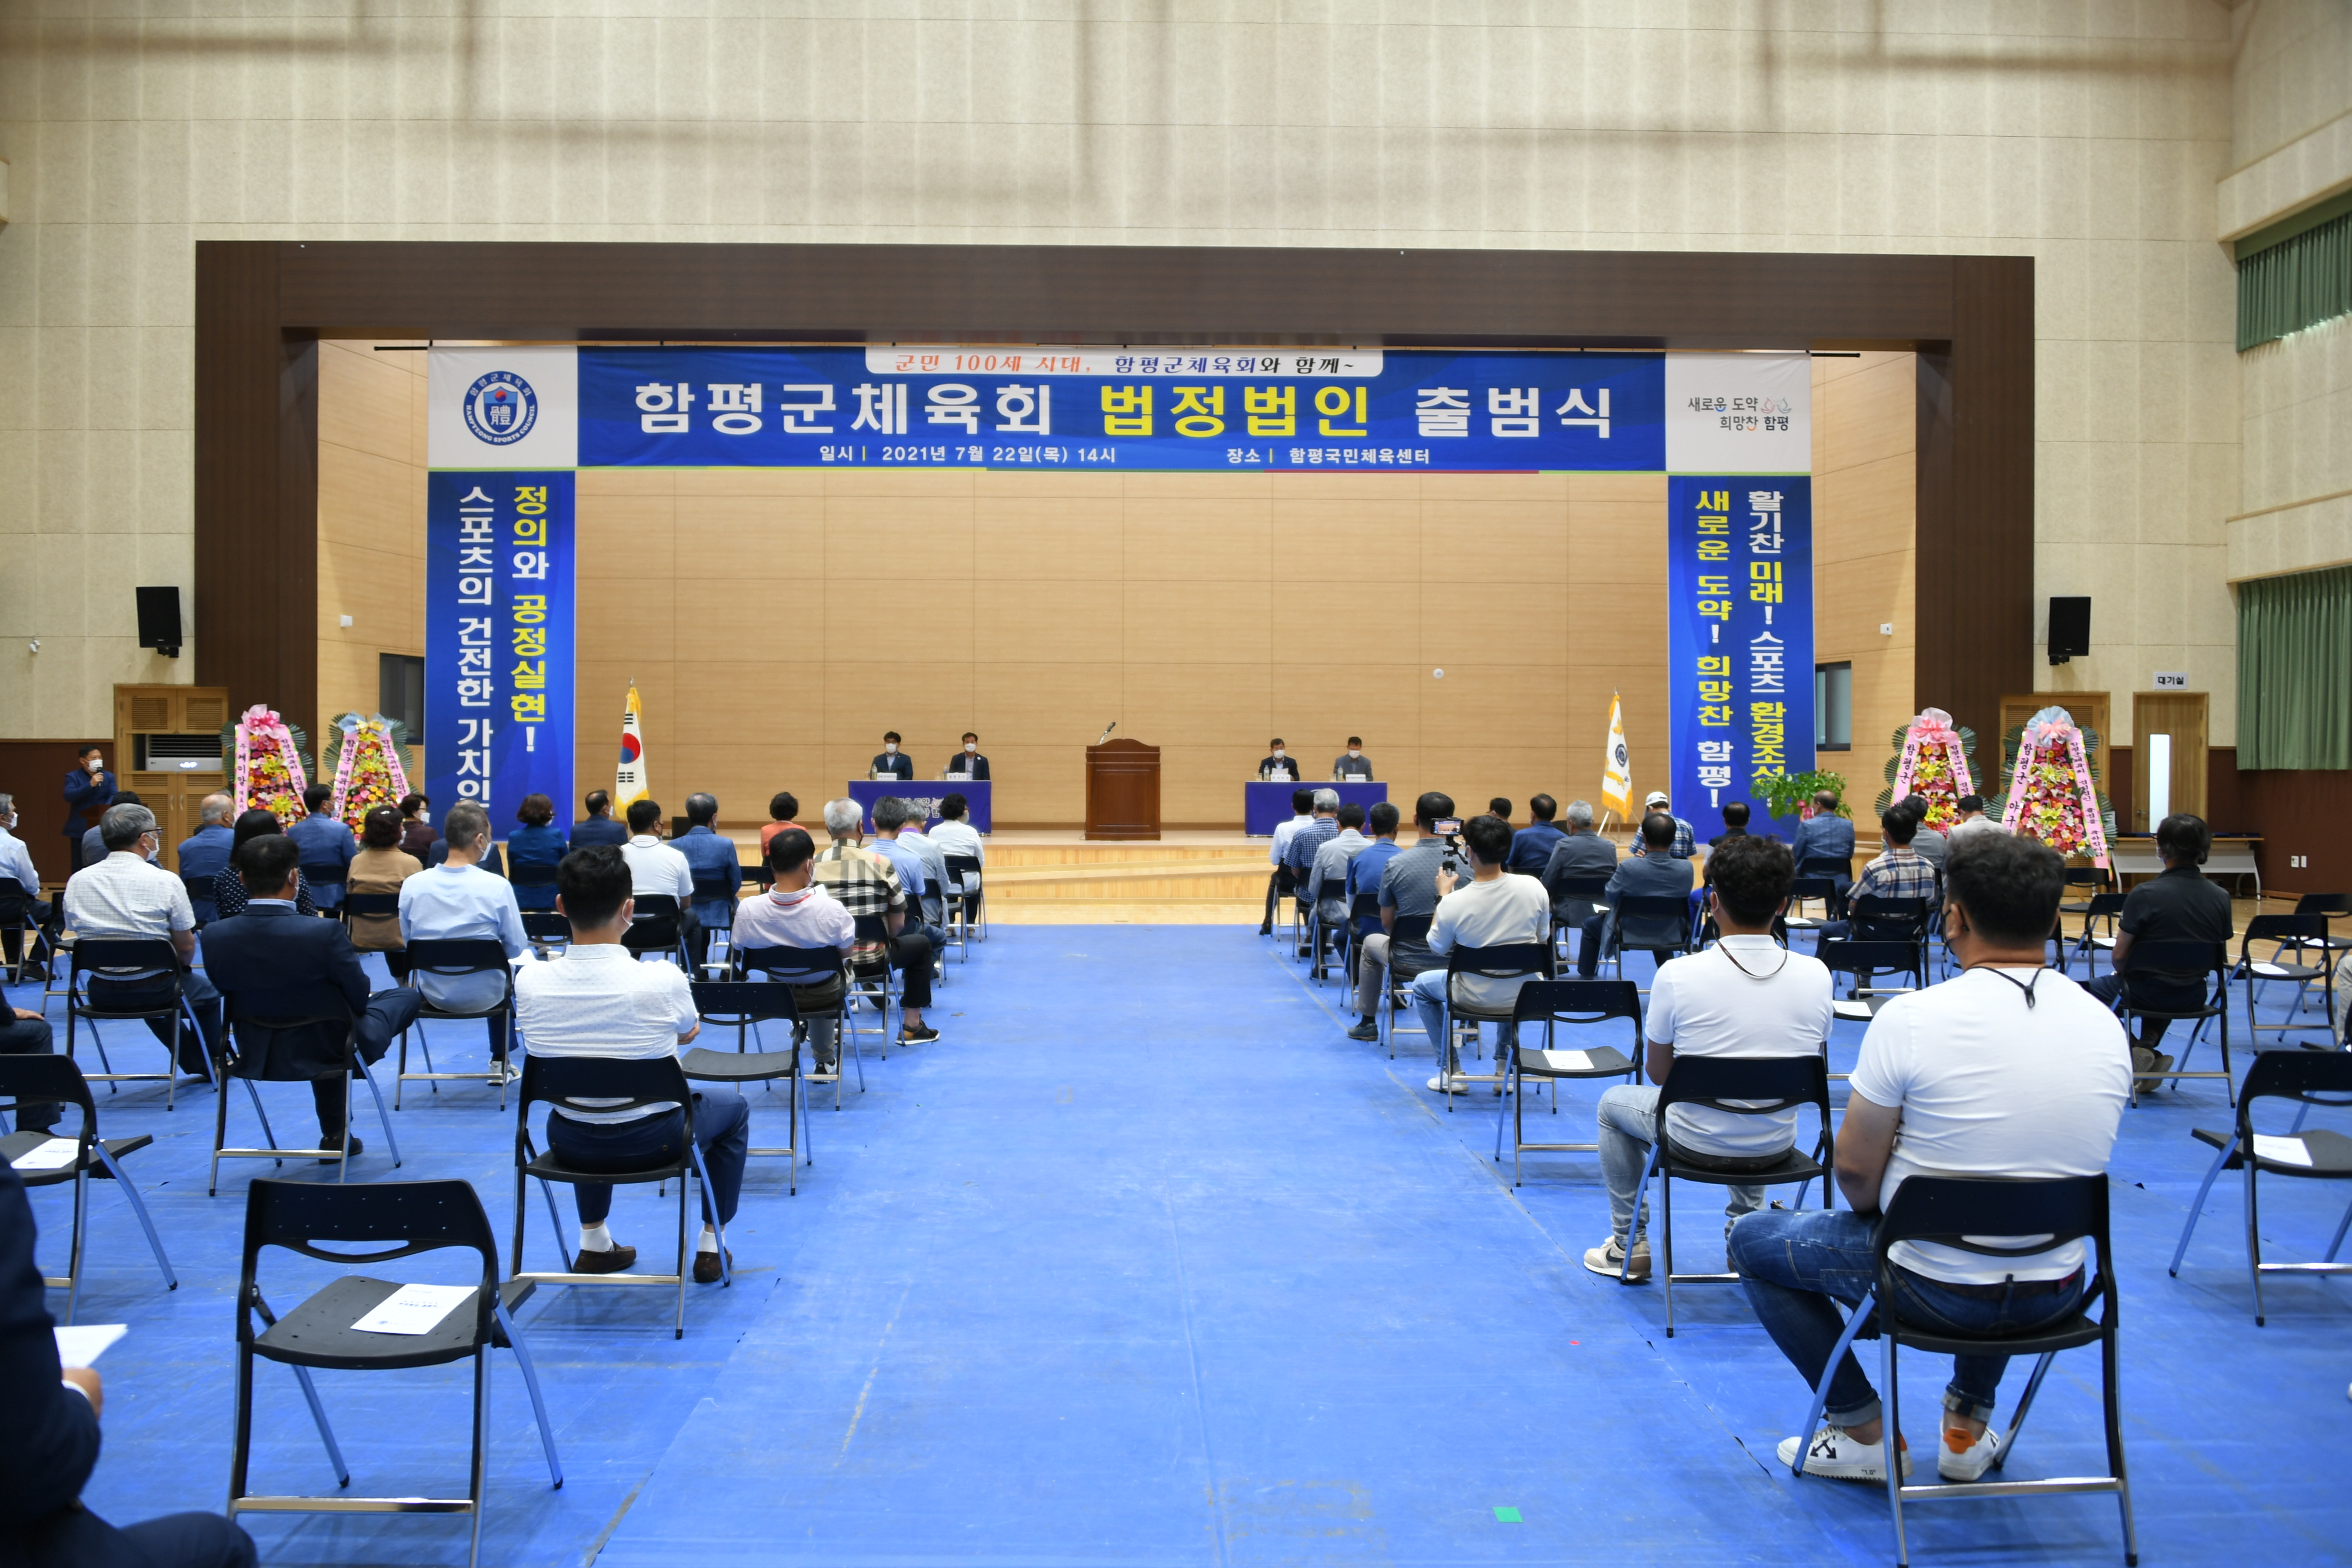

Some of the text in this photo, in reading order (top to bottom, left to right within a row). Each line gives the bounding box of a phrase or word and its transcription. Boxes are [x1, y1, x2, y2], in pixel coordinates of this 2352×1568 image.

[895, 355, 1354, 374] 군민 100세 시대, 함평군체육회와 함께~
[635, 383, 1610, 439] 함평군체육회 법정법인 출범식
[1688, 397, 1758, 412] 새로운 도약
[1720, 416, 1789, 431] 희망찬 함평
[493, 432, 520, 443] SPORTS
[819, 445, 1116, 463] 일시 2021년 7월 22일(목) 14시
[1226, 448, 1429, 464] 장소 함평국민체육센터
[512, 486, 550, 580] 정의와
[1748, 491, 1785, 554] 활기찬
[457, 486, 494, 605] 스포츠의
[1750, 561, 1783, 625] 미래!
[457, 617, 494, 707] 건전한
[1695, 491, 1734, 808] 새로운 도약! 희망찬 함평!
[1750, 631, 1785, 693] 스포츠
[2157, 676, 2184, 685] 대기실
[1900, 743, 1916, 784] 함평군
[2016, 743, 2033, 784] 함평군
